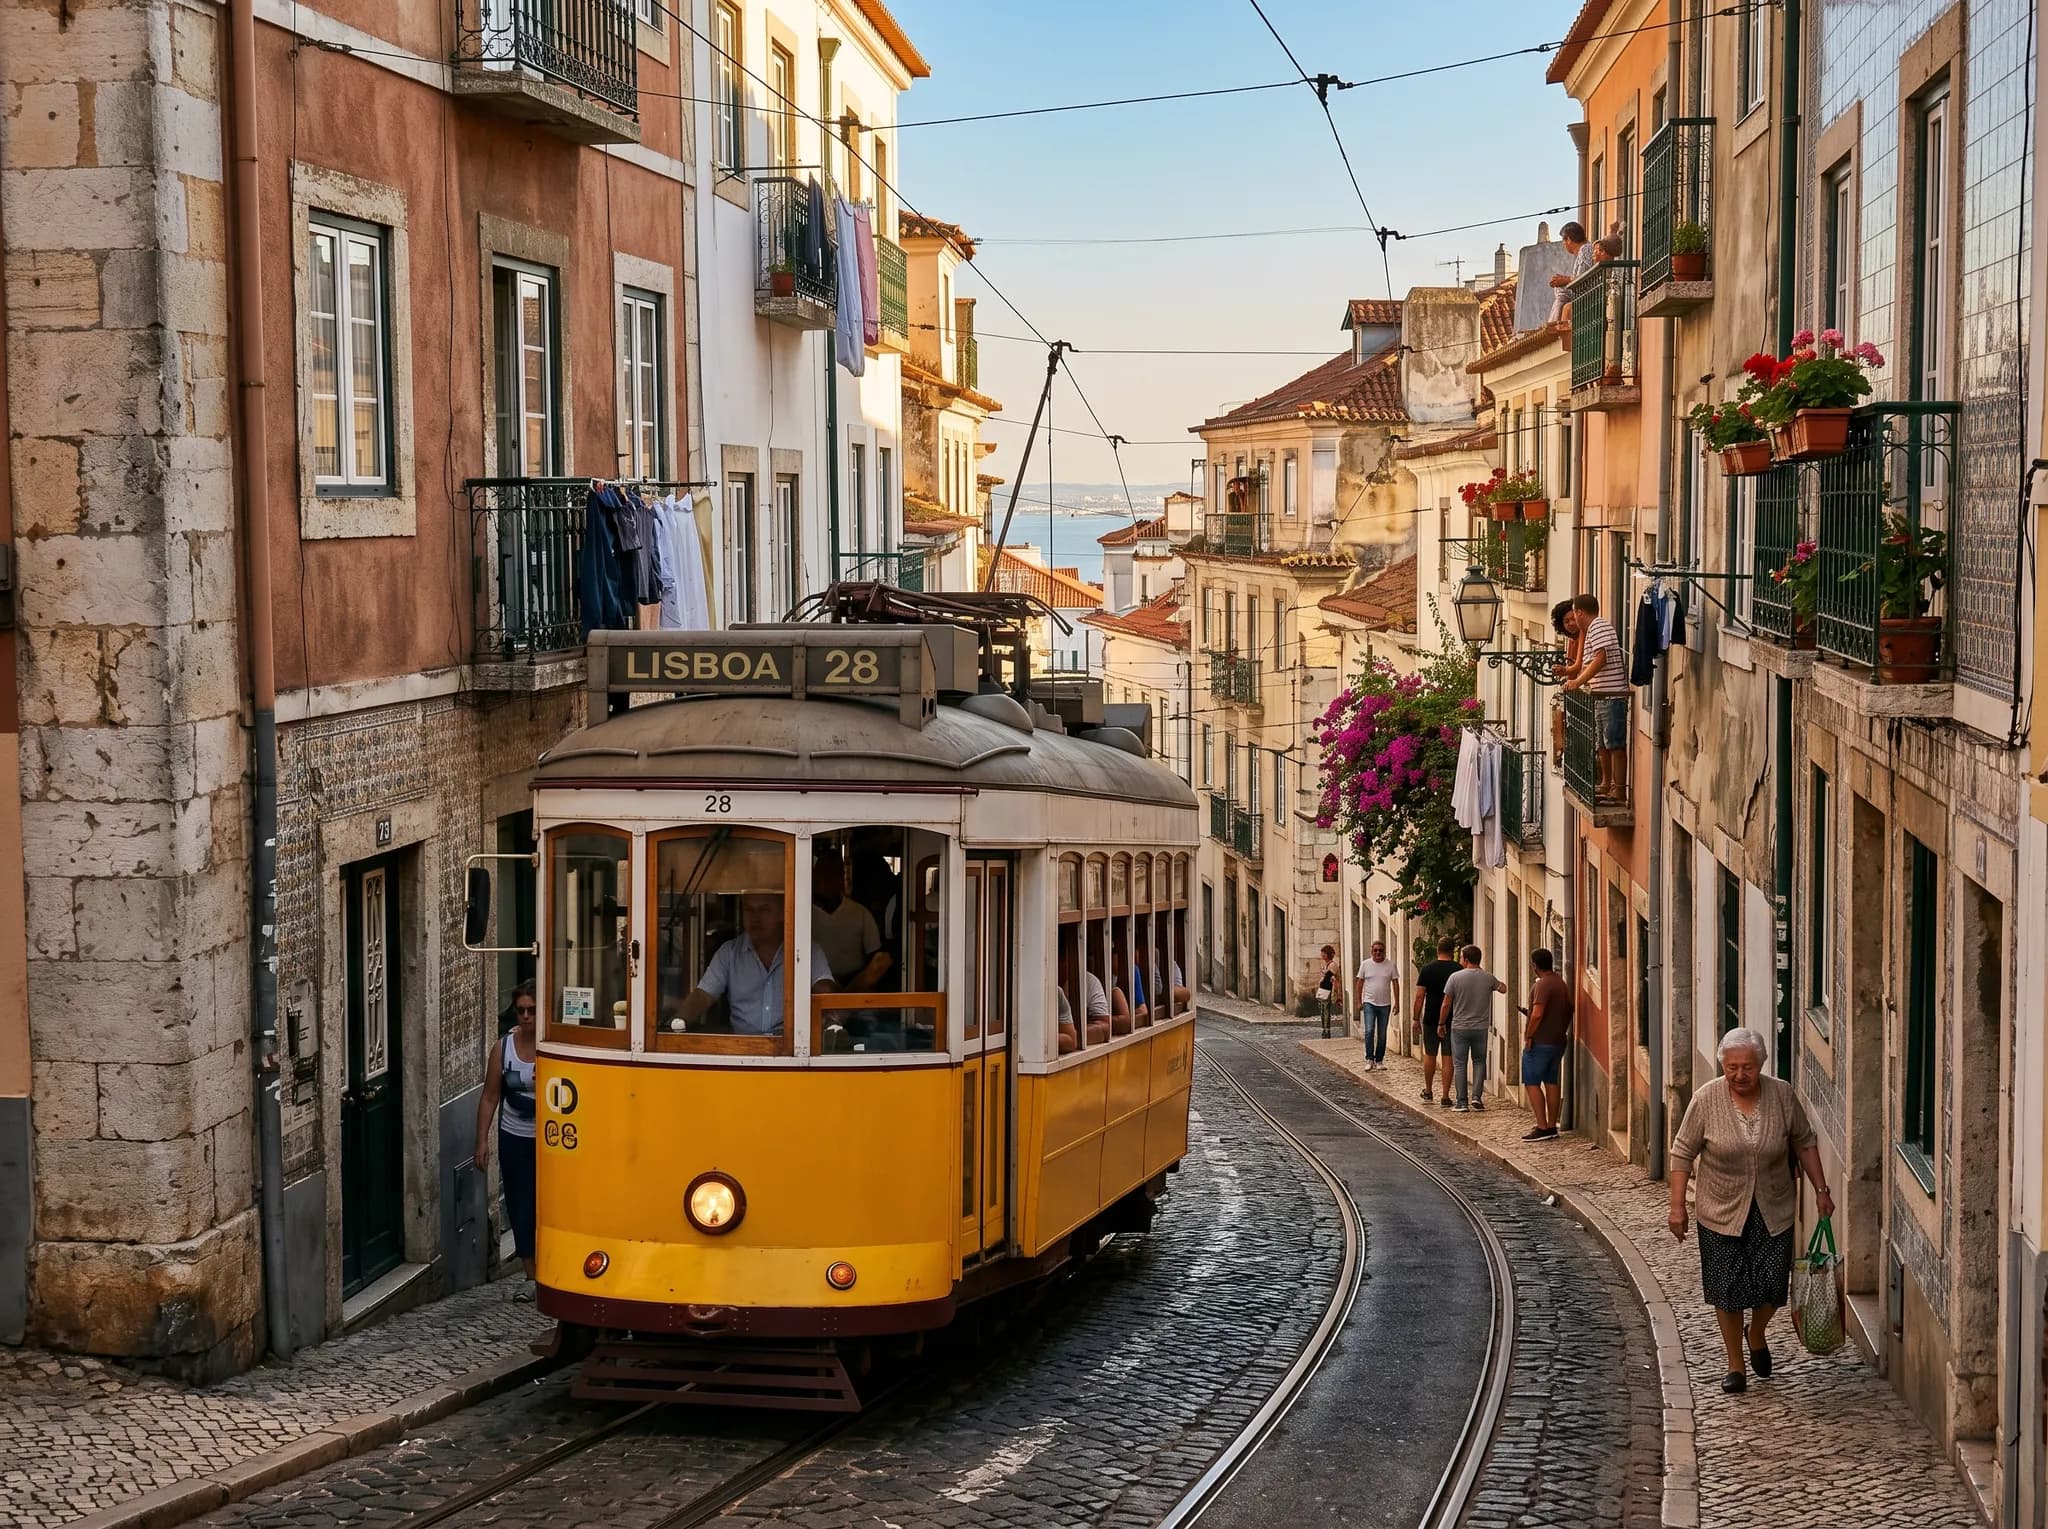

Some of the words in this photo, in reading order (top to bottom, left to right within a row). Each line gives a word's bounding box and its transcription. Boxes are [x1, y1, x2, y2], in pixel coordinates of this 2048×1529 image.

[627, 651, 781, 680] LISBOA
[824, 650, 880, 684] 28
[705, 795, 732, 813] 28
